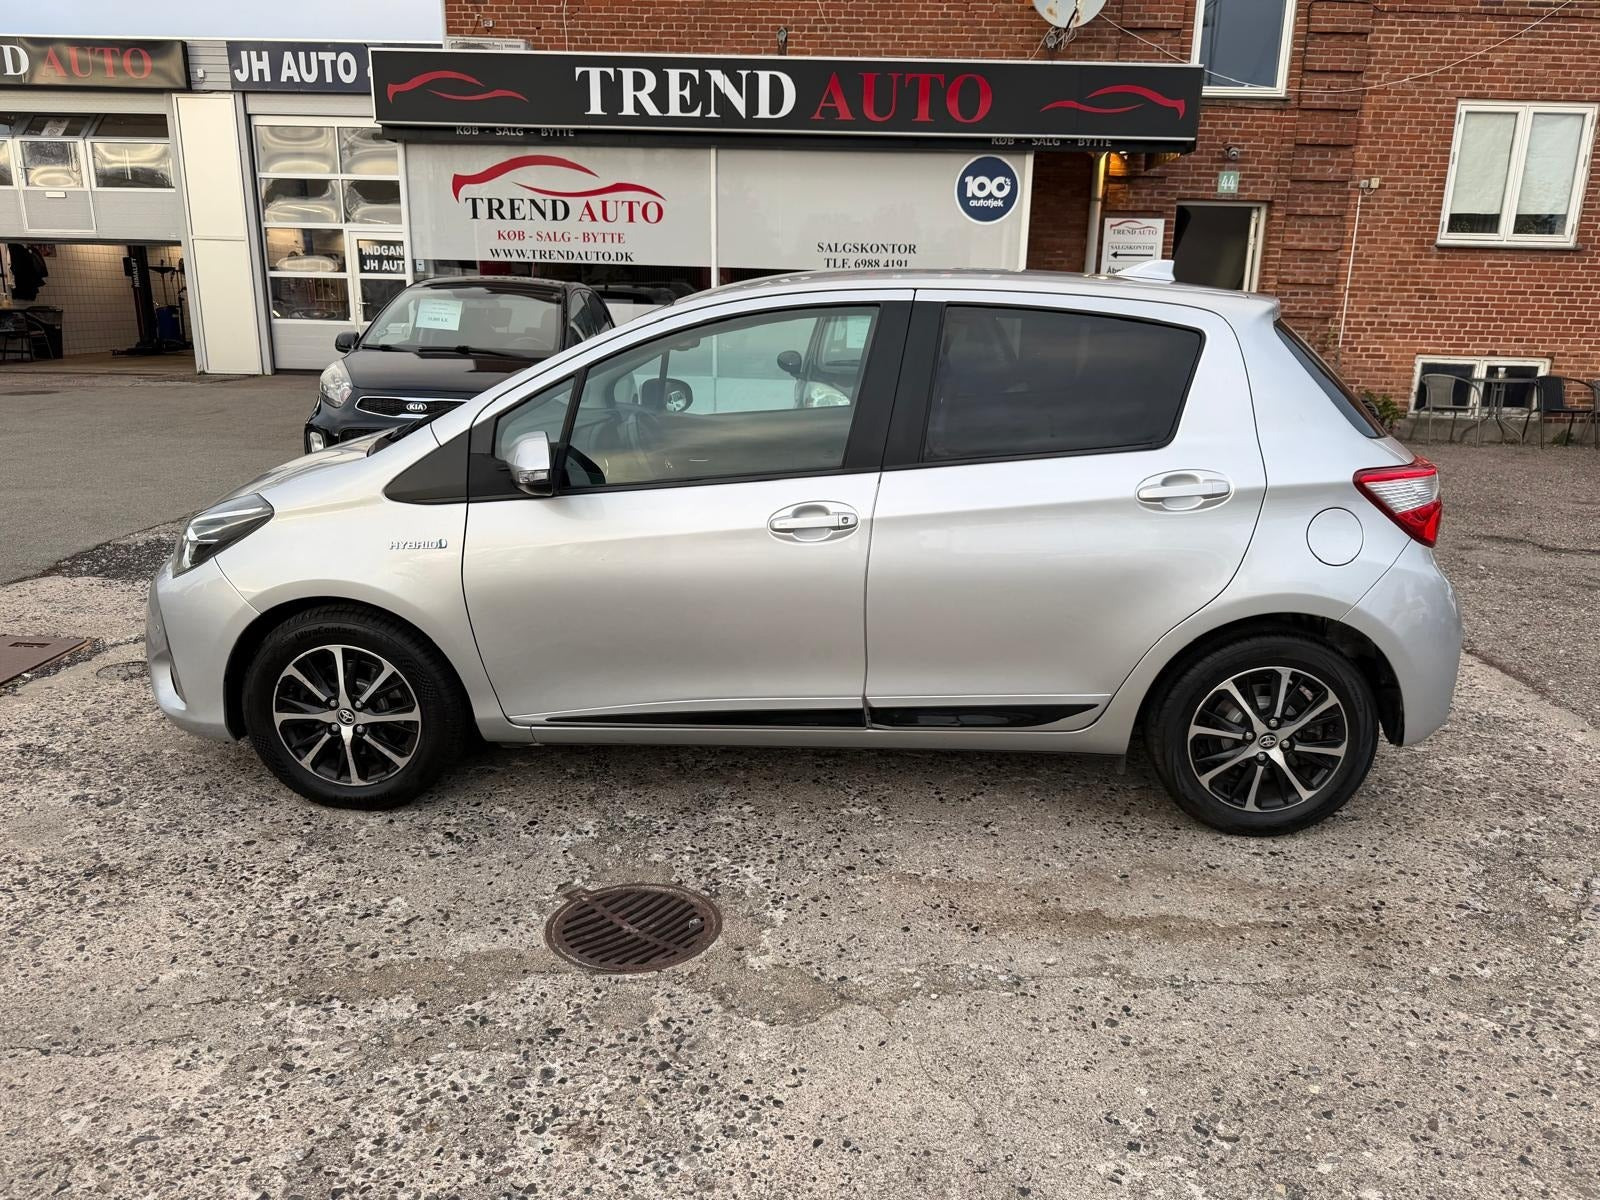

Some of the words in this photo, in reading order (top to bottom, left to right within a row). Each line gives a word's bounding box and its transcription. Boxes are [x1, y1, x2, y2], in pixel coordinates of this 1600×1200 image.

[40, 46, 153, 80] AUTO
[234, 50, 271, 82] JH
[280, 51, 358, 84] AUTO
[575, 66, 797, 120] TREND
[809, 71, 993, 124] AUTO
[456, 126, 480, 136] KØB
[495, 127, 524, 137] SALG
[540, 128, 575, 137] BYTTE
[991, 136, 1015, 145] KØB
[1031, 138, 1061, 146] SALG
[1077, 138, 1112, 147] BYTTE
[1220, 175, 1236, 191] 44
[969, 198, 1004, 209] autotjek
[464, 197, 571, 222] TREND
[578, 200, 665, 225] AUTO
[497, 230, 526, 241] KØB
[536, 231, 571, 243] SALG
[582, 232, 626, 244] BYTTE
[490, 248, 634, 262] WWW.TRENDAUTO.DK
[817, 242, 917, 254] SALGSKONTOR
[363, 259, 379, 271] JH
[824, 258, 851, 269] TLF.
[854, 258, 880, 269] 6988
